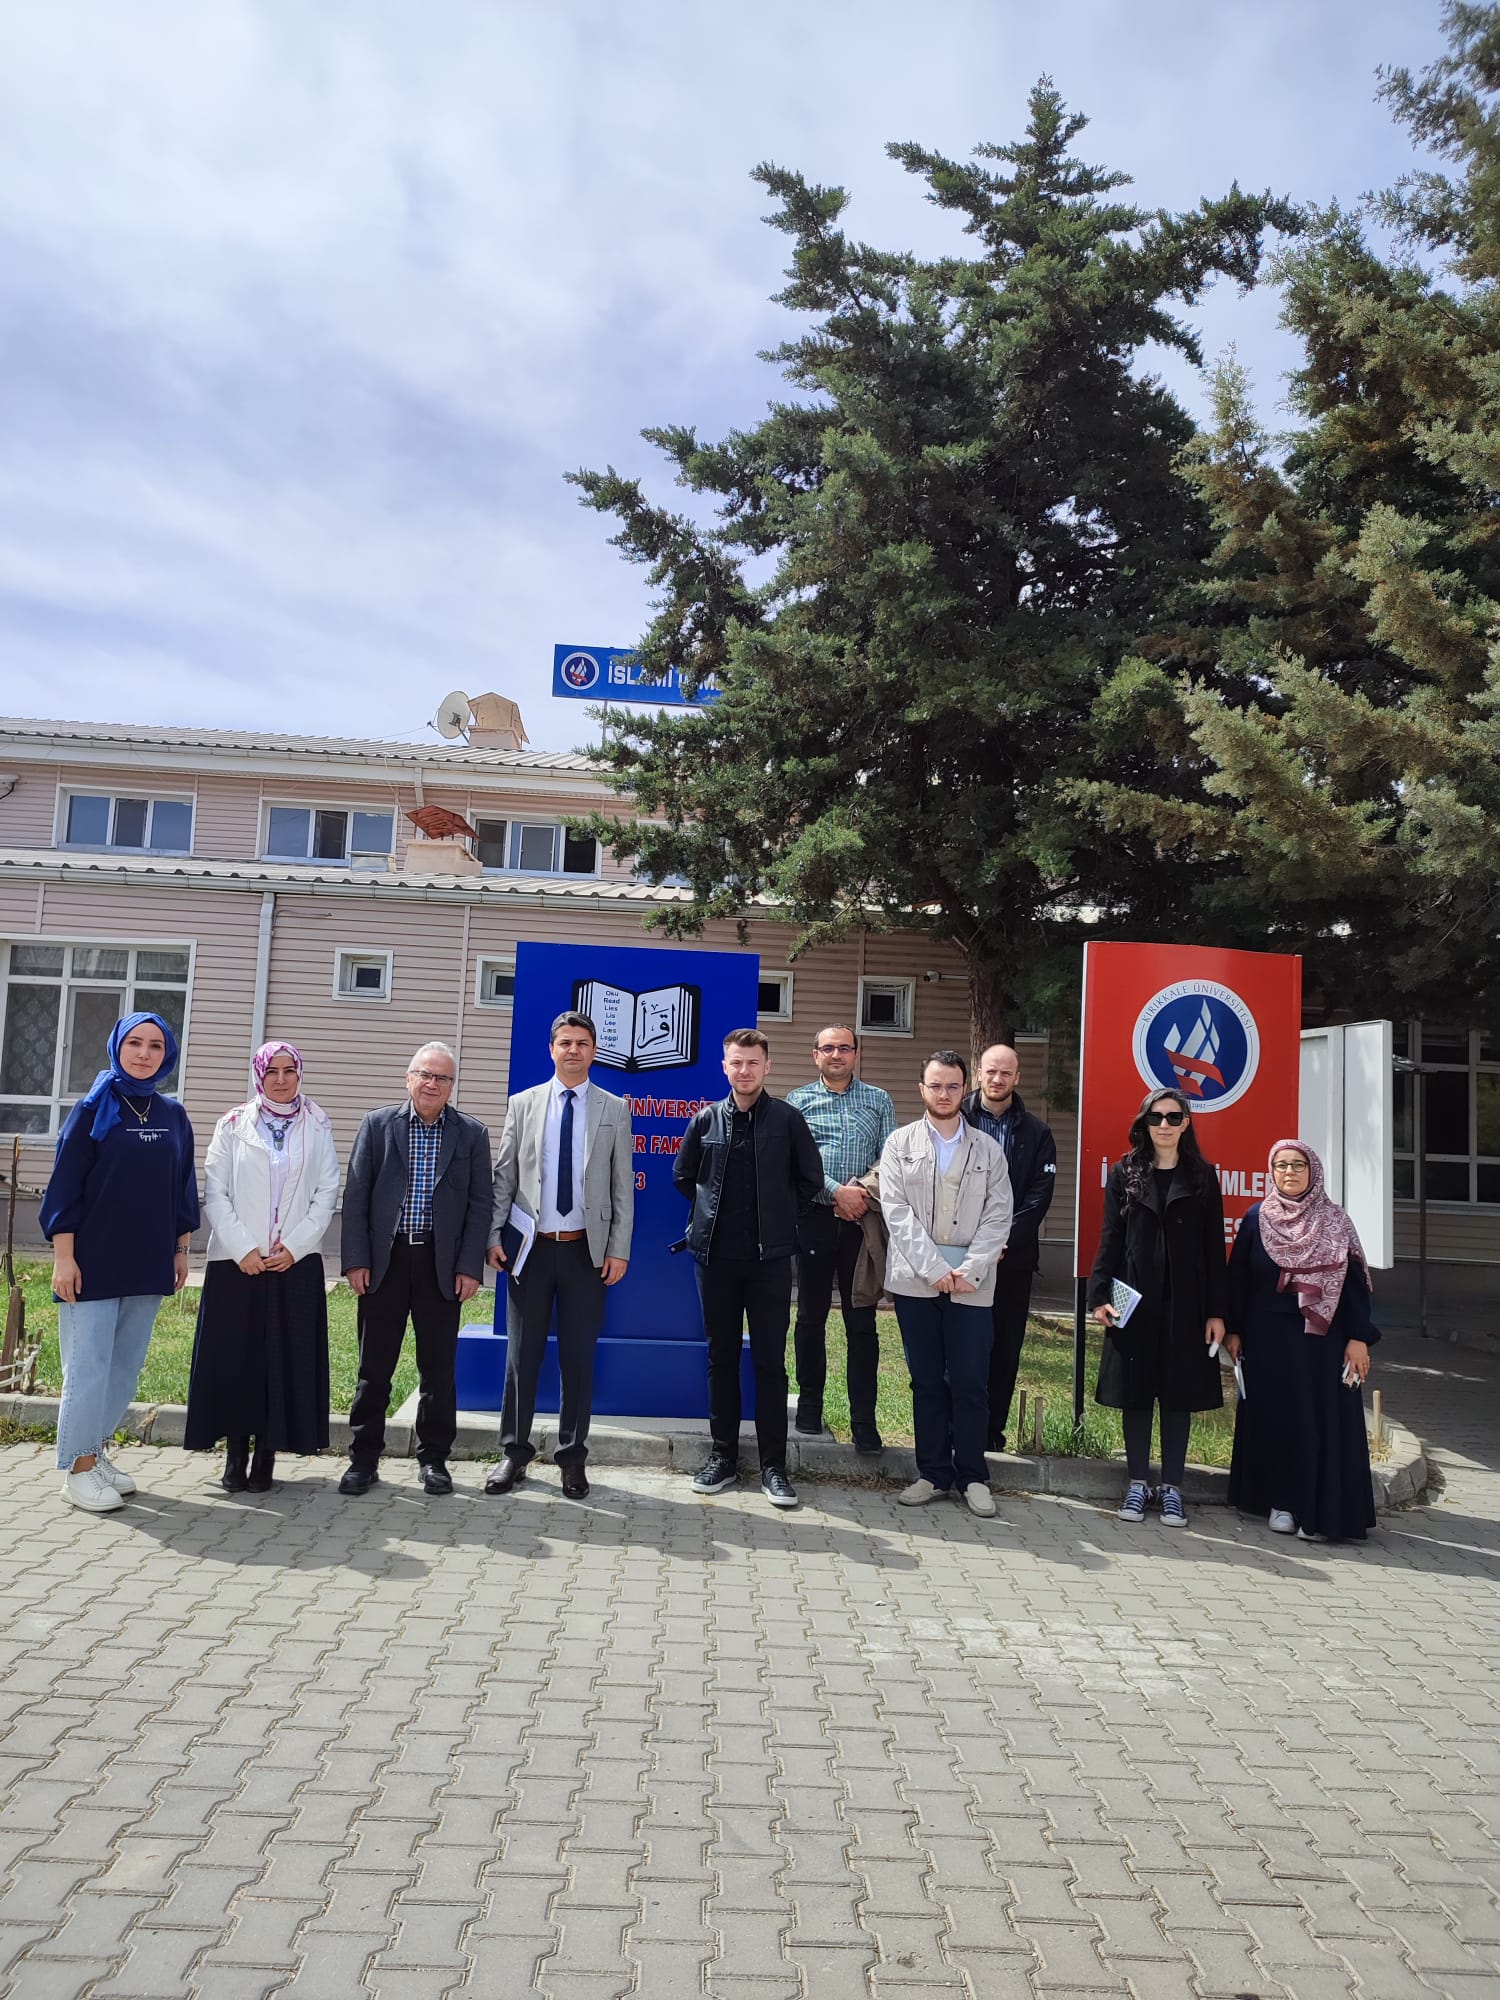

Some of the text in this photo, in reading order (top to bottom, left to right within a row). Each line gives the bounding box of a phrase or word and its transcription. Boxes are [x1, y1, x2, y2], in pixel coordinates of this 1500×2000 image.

[603, 997, 621, 1005] Read
[1142, 983, 1253, 1029] KIRIKKALE ÜNİVERSİTESİ
[623, 1094, 716, 1119] ÜNİVERSİ
